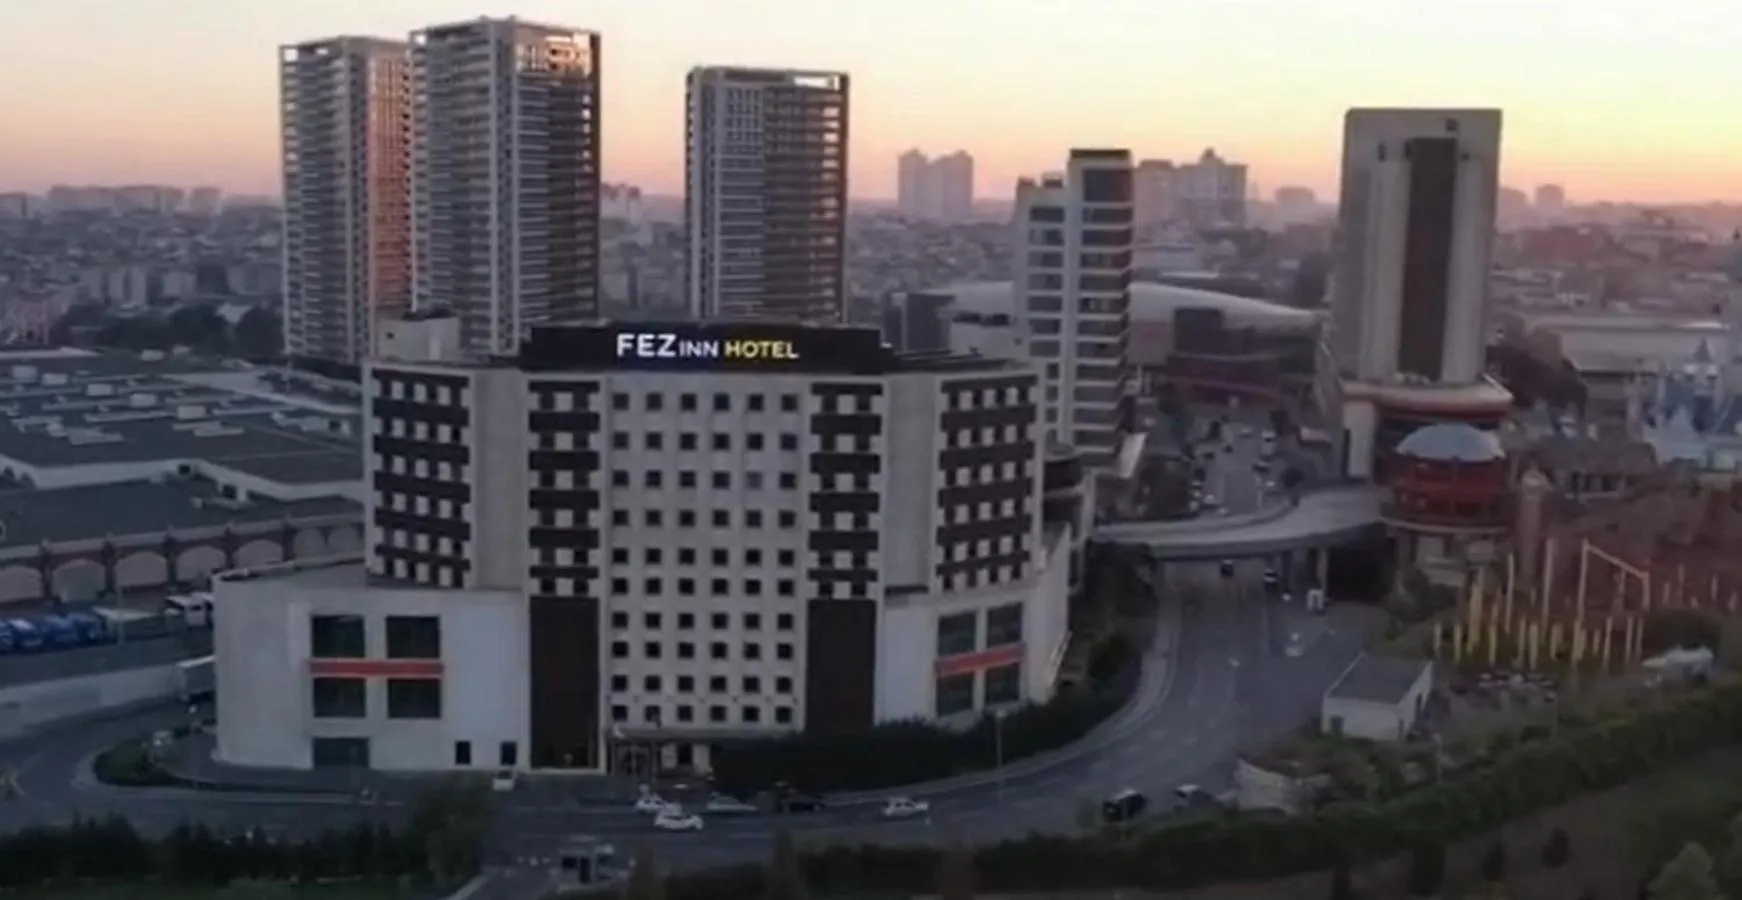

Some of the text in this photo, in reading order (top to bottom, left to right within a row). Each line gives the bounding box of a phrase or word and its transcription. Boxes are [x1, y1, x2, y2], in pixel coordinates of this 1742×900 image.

[616, 333, 800, 360] FEZ INN HOTEL
